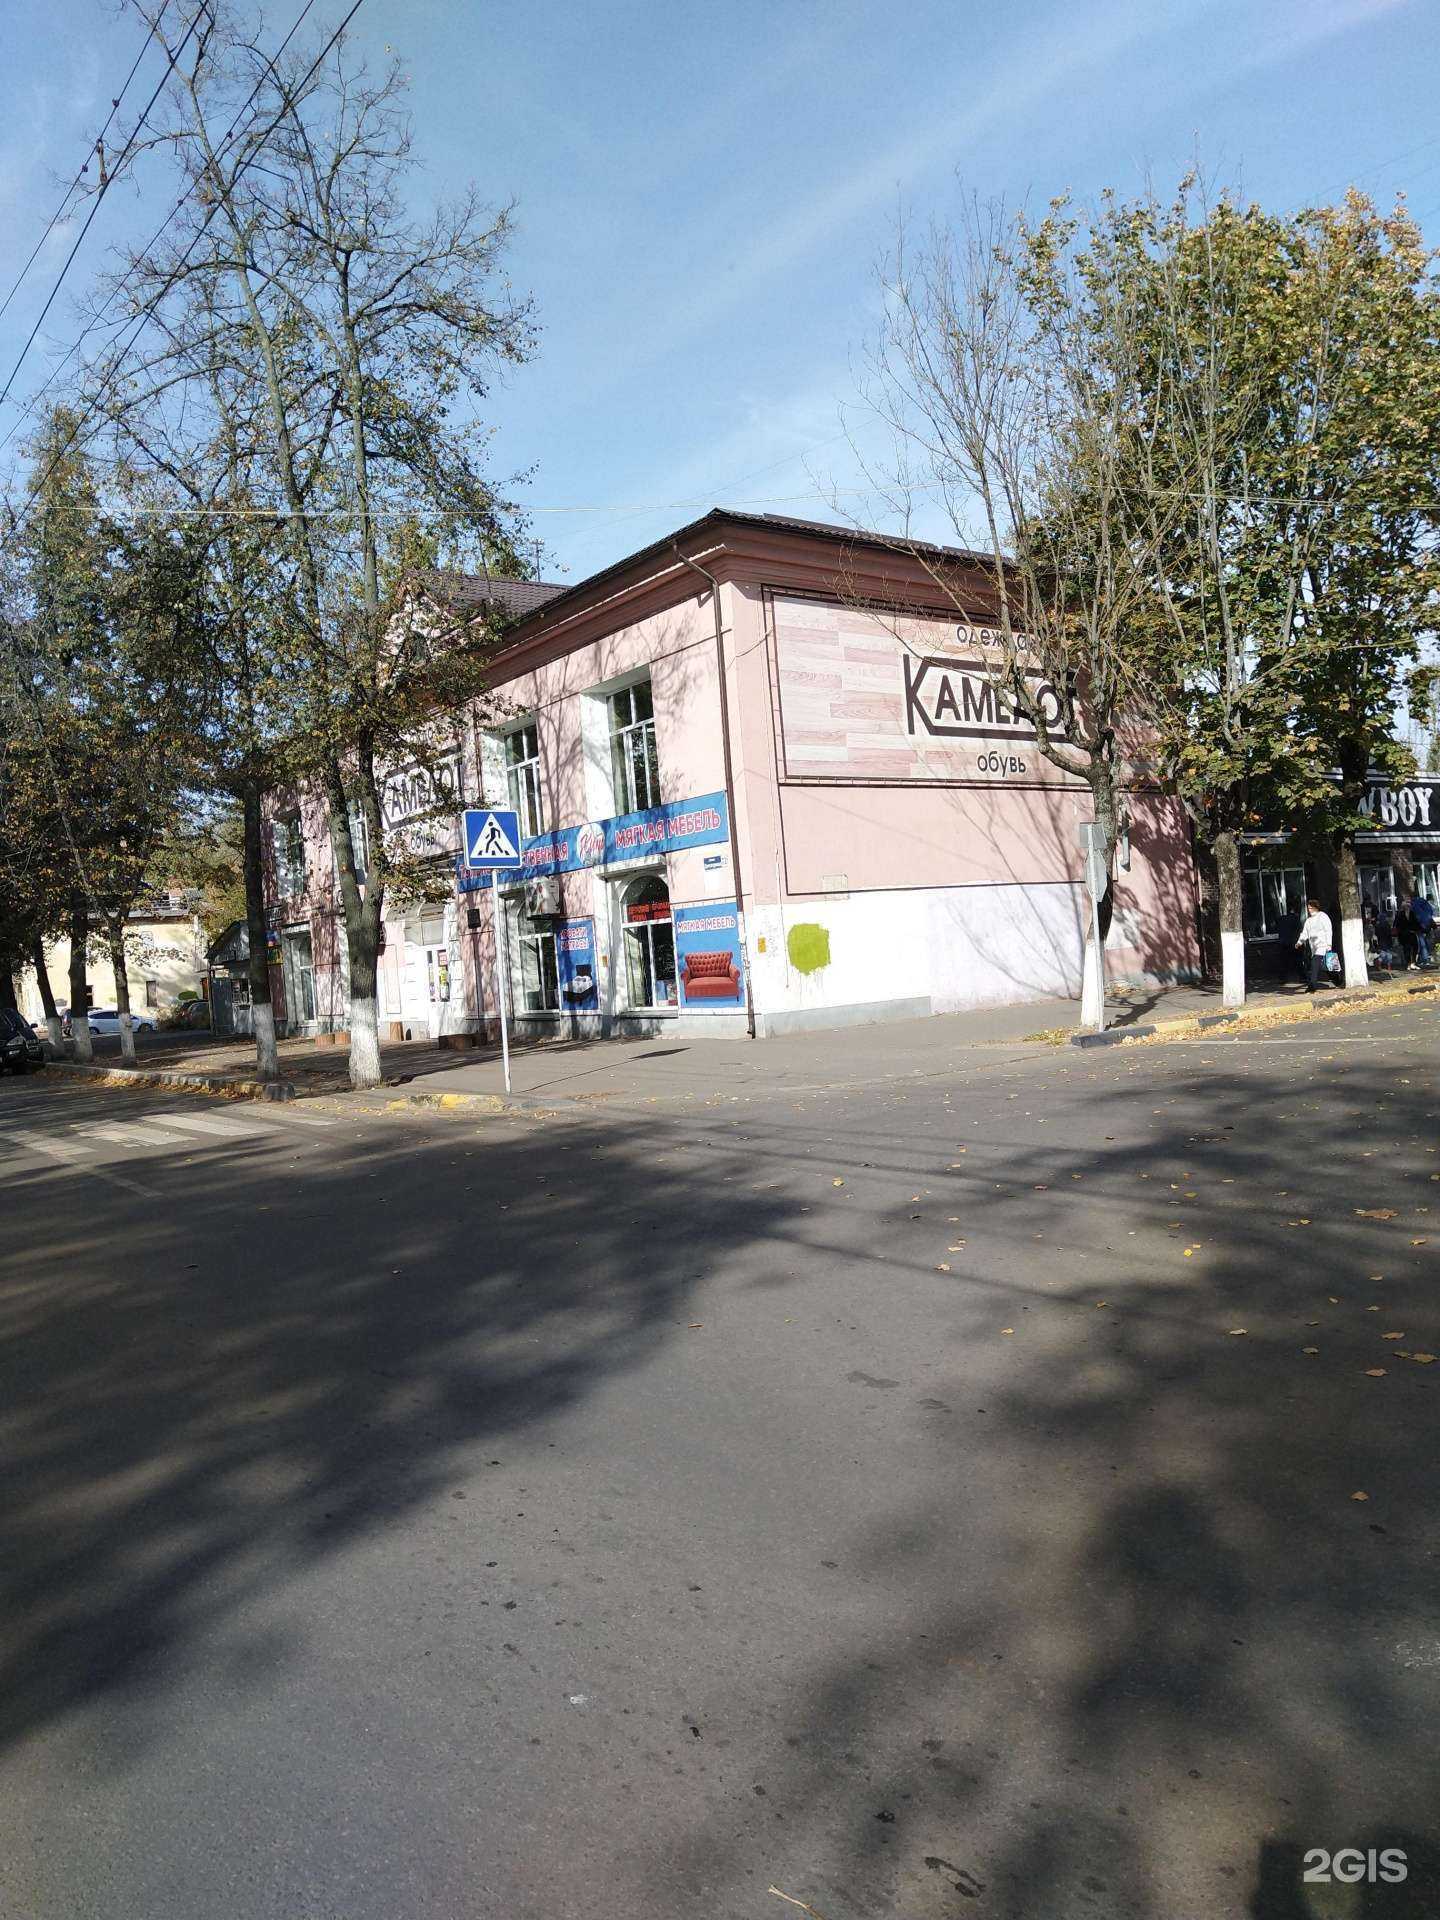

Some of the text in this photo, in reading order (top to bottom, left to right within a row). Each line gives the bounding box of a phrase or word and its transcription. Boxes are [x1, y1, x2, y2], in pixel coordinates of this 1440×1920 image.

[977, 750, 1027, 774] обувь
[615, 819, 666, 850] МЯГКАЯ
[667, 807, 721, 839] МЕБЕЛЬ
[676, 914, 737, 934] МЯГКАЯ МЕБЕЛЬ
